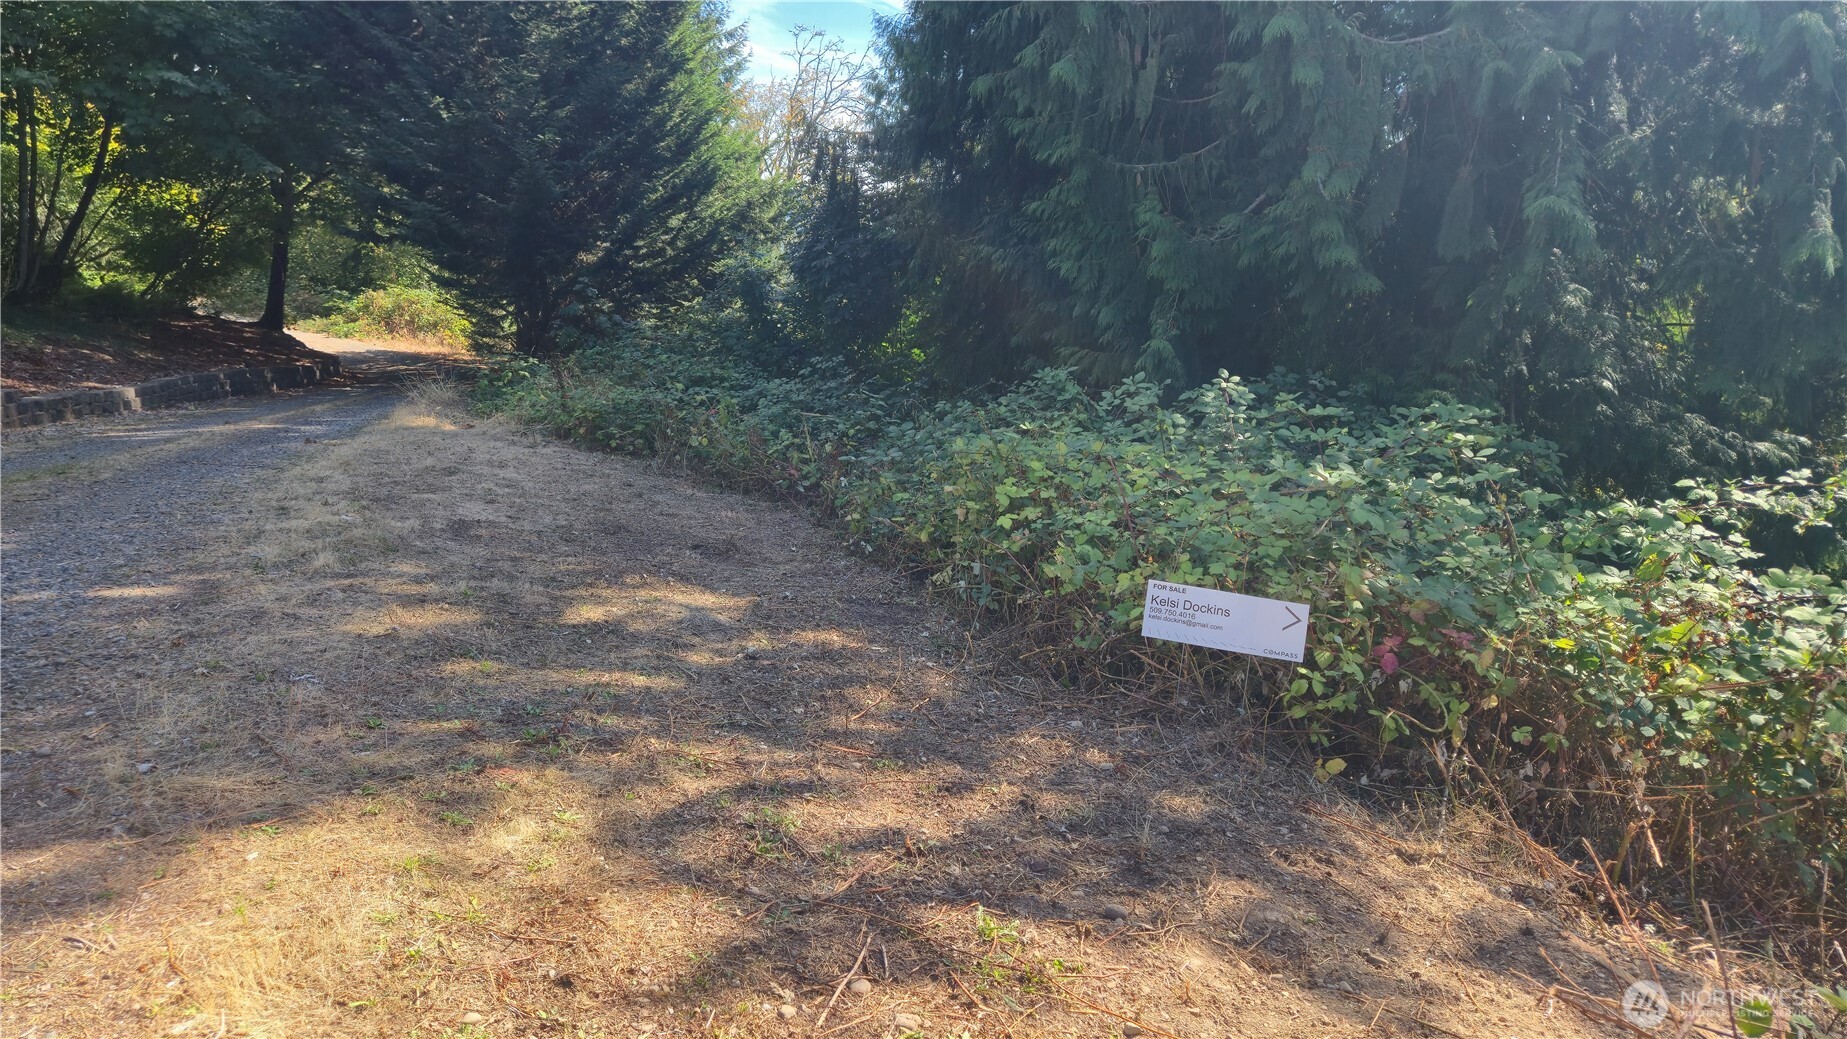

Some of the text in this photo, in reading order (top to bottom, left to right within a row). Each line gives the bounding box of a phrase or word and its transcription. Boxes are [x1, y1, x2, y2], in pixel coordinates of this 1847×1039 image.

[1169, 586, 1187, 594] SALE
[1150, 595, 1231, 617] Kelsi Dockins
[1149, 607, 1196, 620] 509.750.4016
[1149, 614, 1223, 631] kelsi.dockins@gmail.com
[1263, 649, 1298, 659] COMPASS
